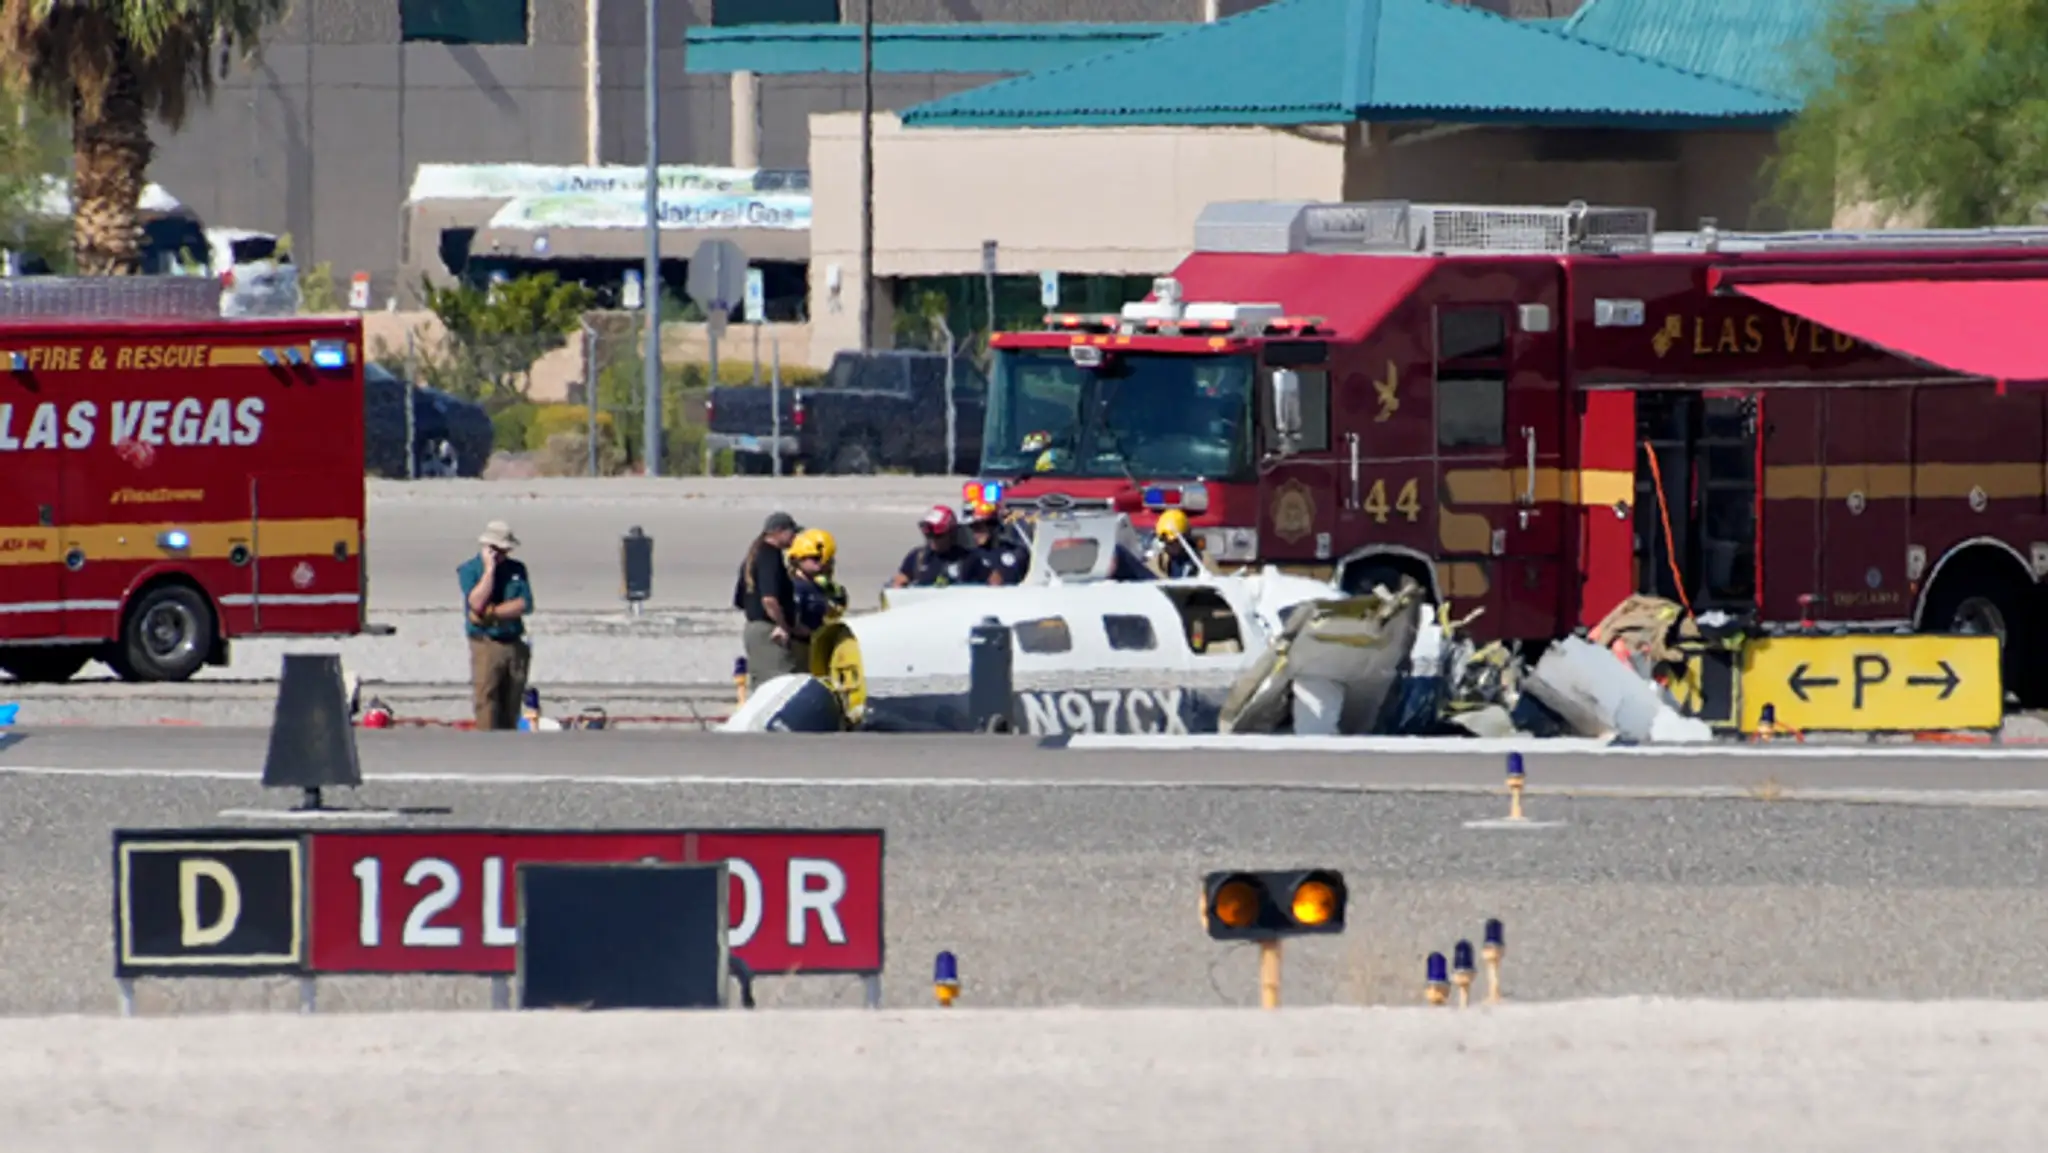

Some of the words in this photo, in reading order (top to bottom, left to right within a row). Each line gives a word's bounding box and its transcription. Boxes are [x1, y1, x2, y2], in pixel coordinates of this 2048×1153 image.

[748, 201, 792, 222] Gas
[1692, 315, 1763, 354] LAS
[28, 346, 82, 371] FIRE
[88, 346, 107, 370] &
[116, 345, 209, 369] RESCUE
[0, 402, 98, 449] LAS
[110, 396, 265, 447] VEGAS
[1364, 479, 1421, 524] 44
[1853, 653, 1891, 709] P
[1021, 690, 1188, 735] N97CX
[181, 859, 241, 947] D
